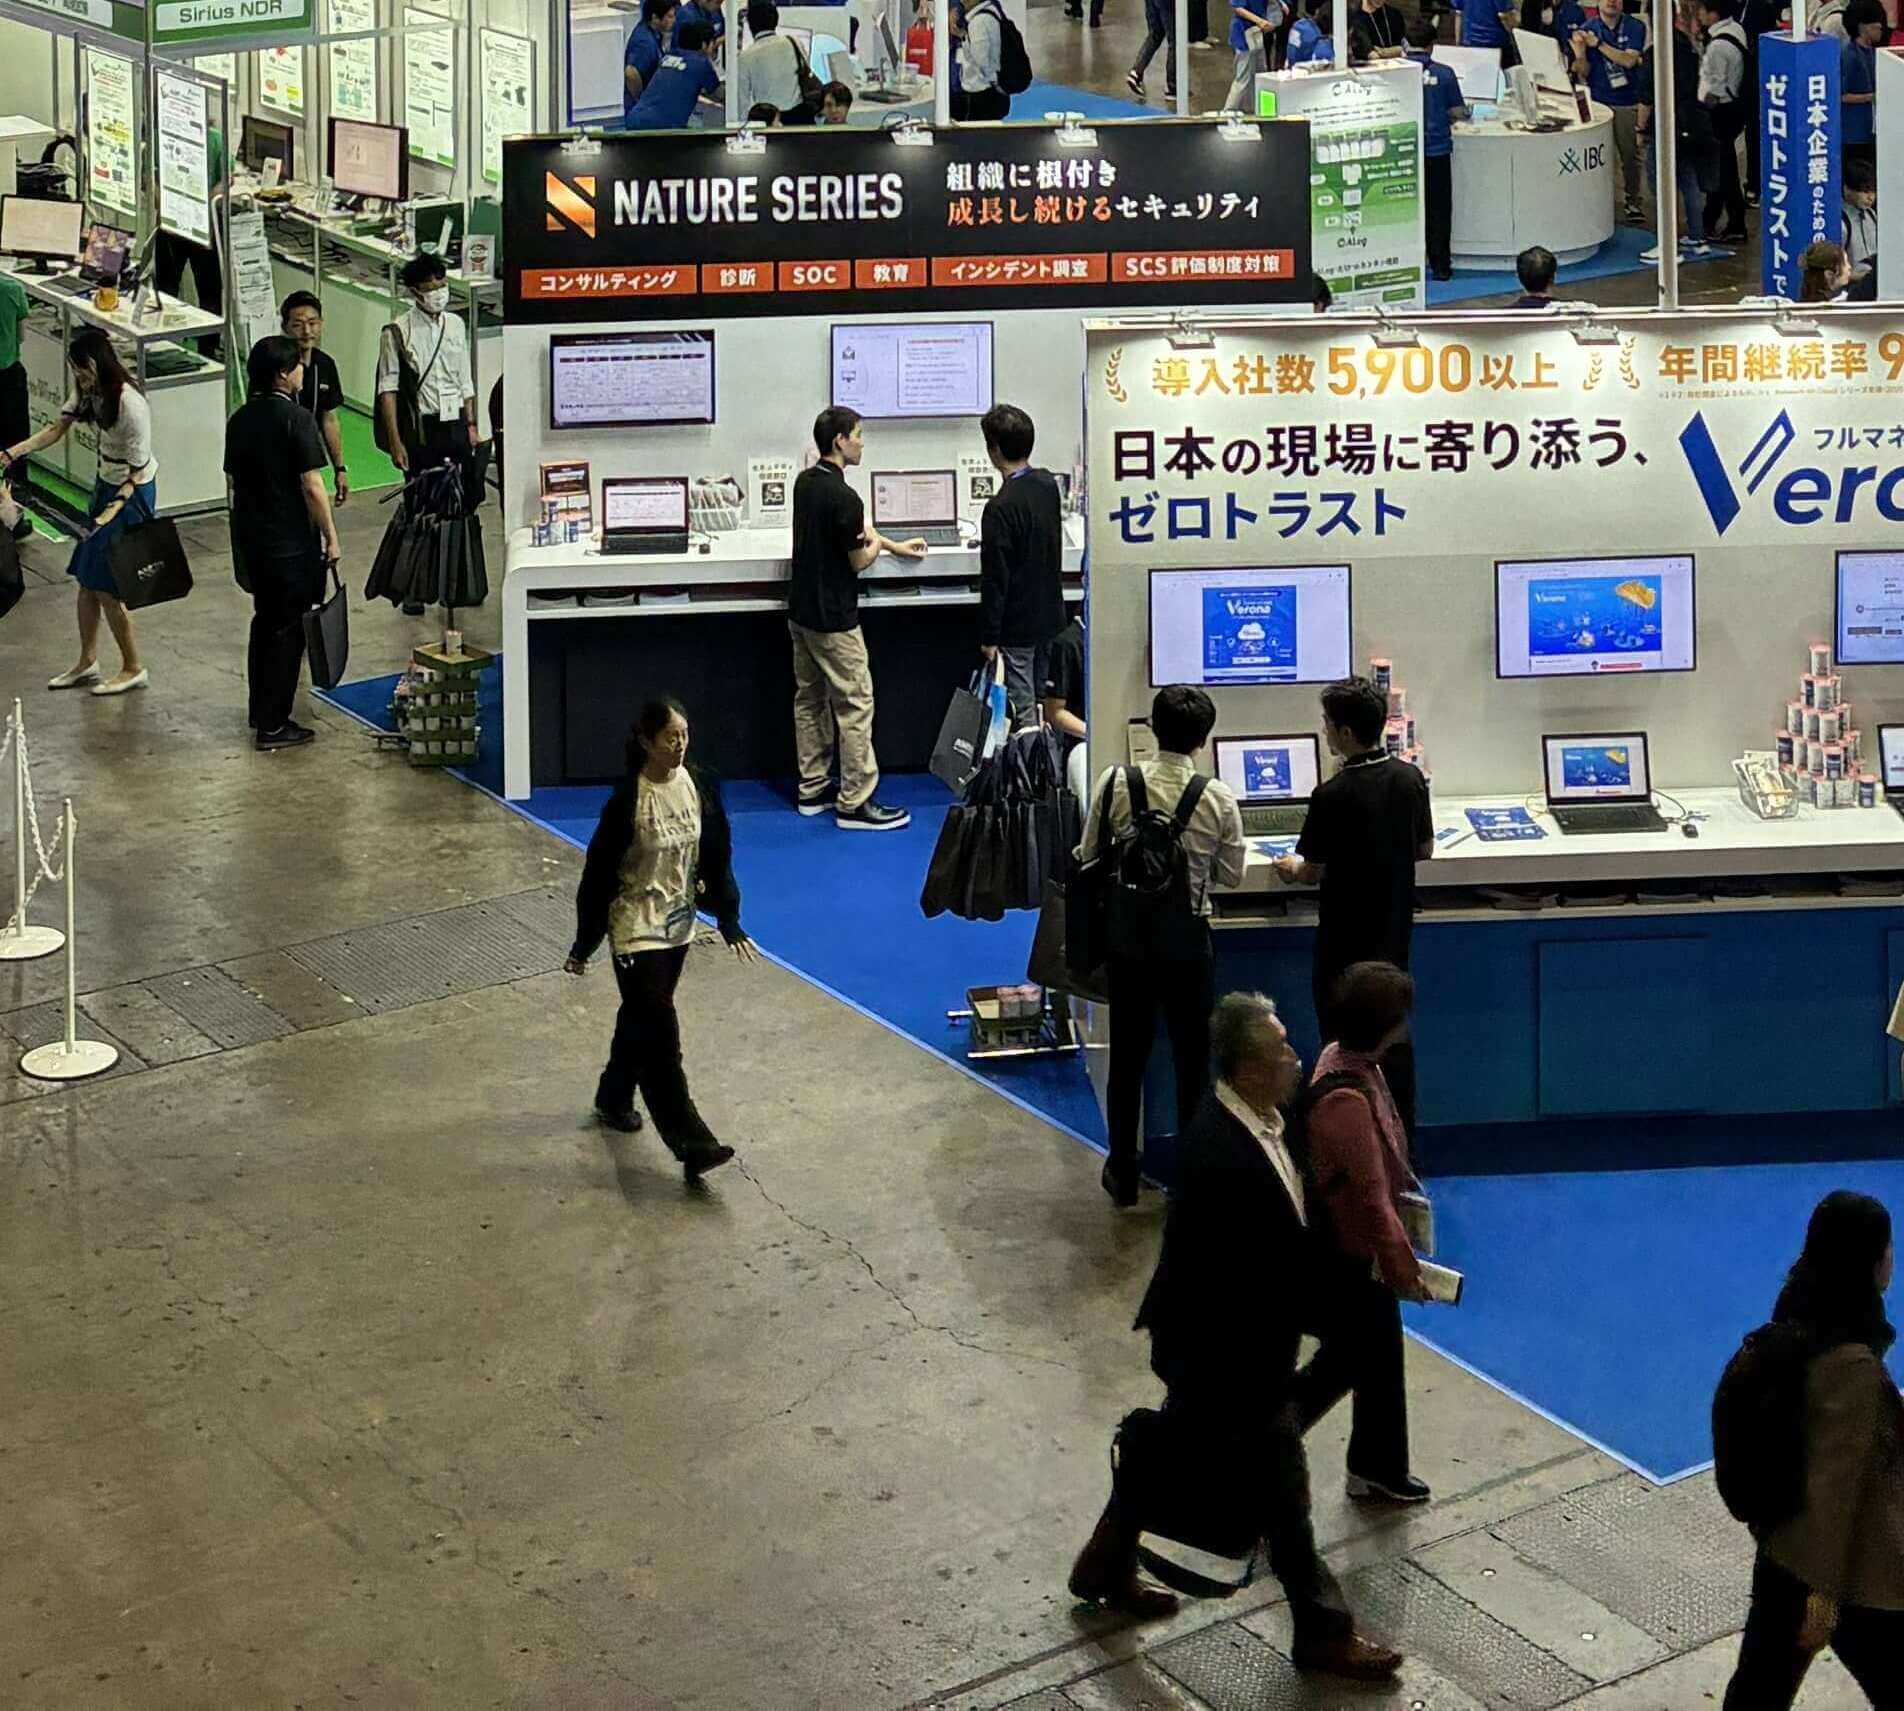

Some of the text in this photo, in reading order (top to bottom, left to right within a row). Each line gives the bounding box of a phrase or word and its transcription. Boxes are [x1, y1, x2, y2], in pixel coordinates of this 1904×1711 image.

[178, 3, 236, 25] Sirius
[1582, 144, 1606, 174] IBC
[1806, 74, 1830, 243] 日本企業のための
[945, 159, 1118, 194] 組織に根付き
[1765, 73, 1790, 295] ゼロトラストで
[612, 172, 905, 227] NATURE SERIES
[945, 191, 1262, 228] 成長し続けるセキュリティ
[538, 269, 678, 293] コンサルティング
[718, 263, 758, 288] 診断
[791, 264, 838, 286] SOC
[872, 261, 910, 286] 教育
[949, 255, 1091, 280] インシデント調査
[1109, 416, 1651, 485] 日本の現場に寄り添う、
[1106, 484, 1409, 545] ゼロトラスト
